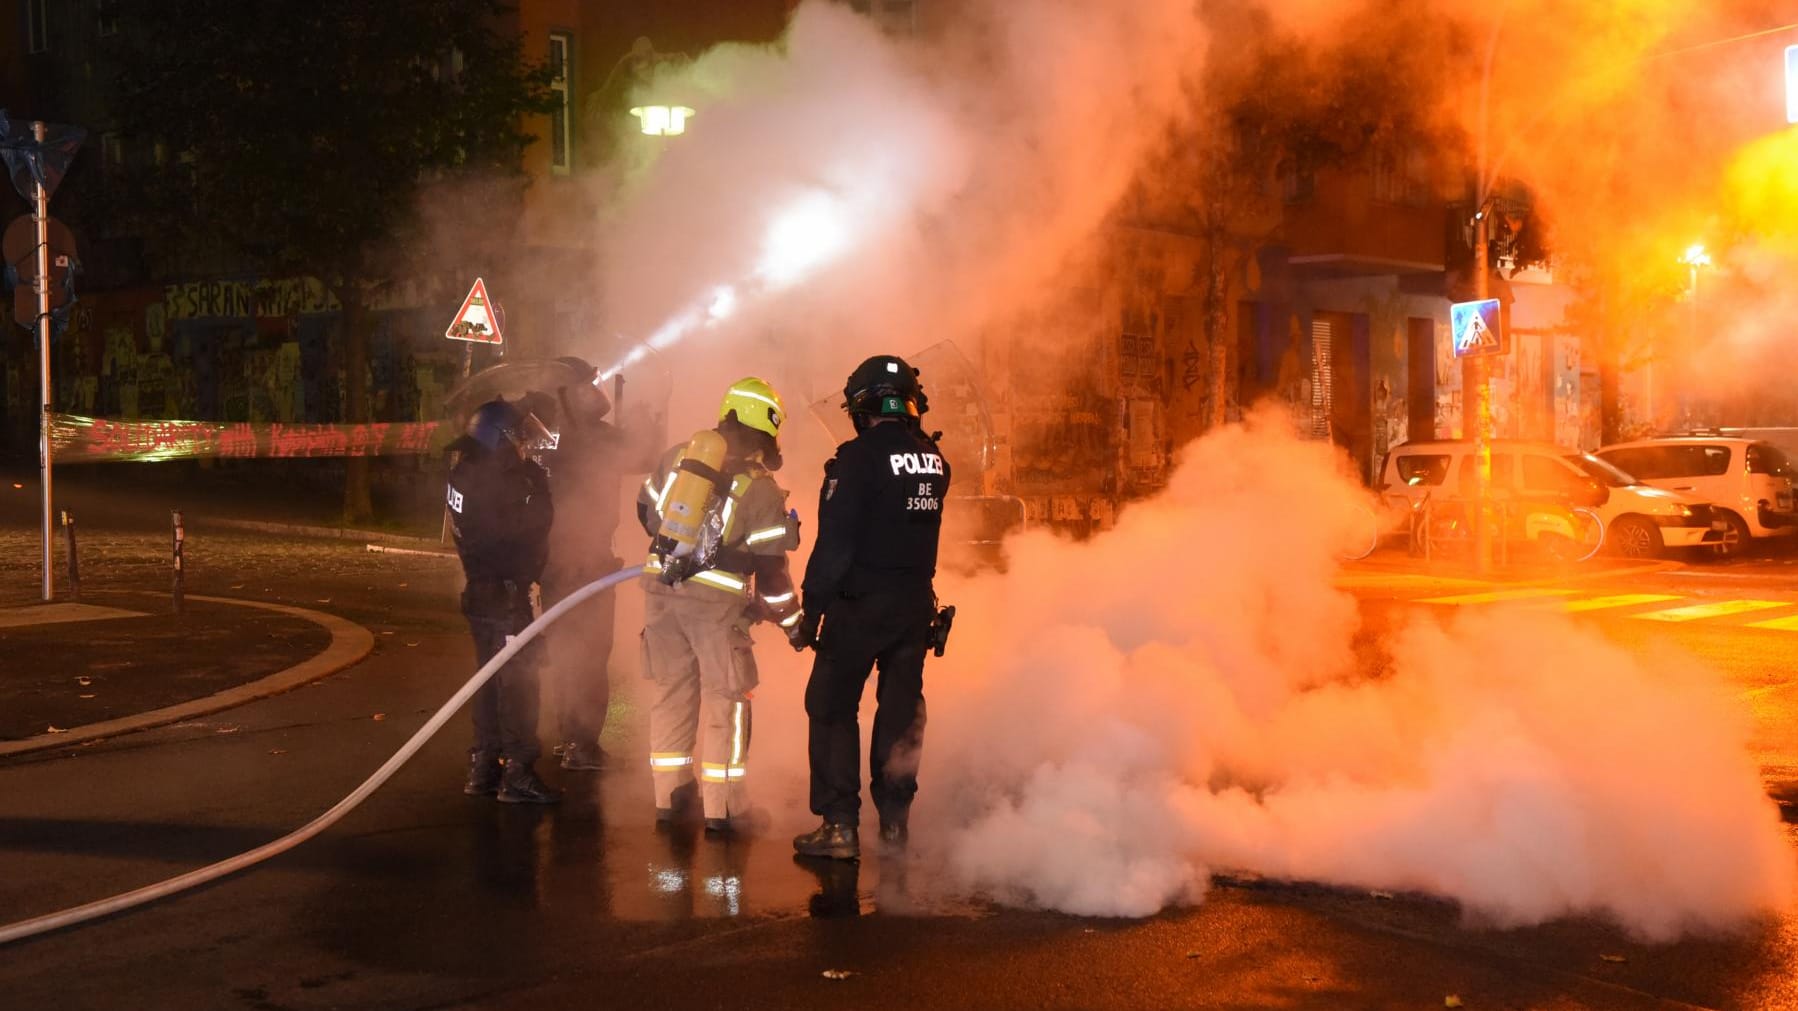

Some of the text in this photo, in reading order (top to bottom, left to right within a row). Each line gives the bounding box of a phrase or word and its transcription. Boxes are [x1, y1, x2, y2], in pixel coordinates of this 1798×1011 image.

[890, 452, 944, 476] POLIZEI
[918, 482, 932, 496] BE
[906, 497, 939, 510] 35006
